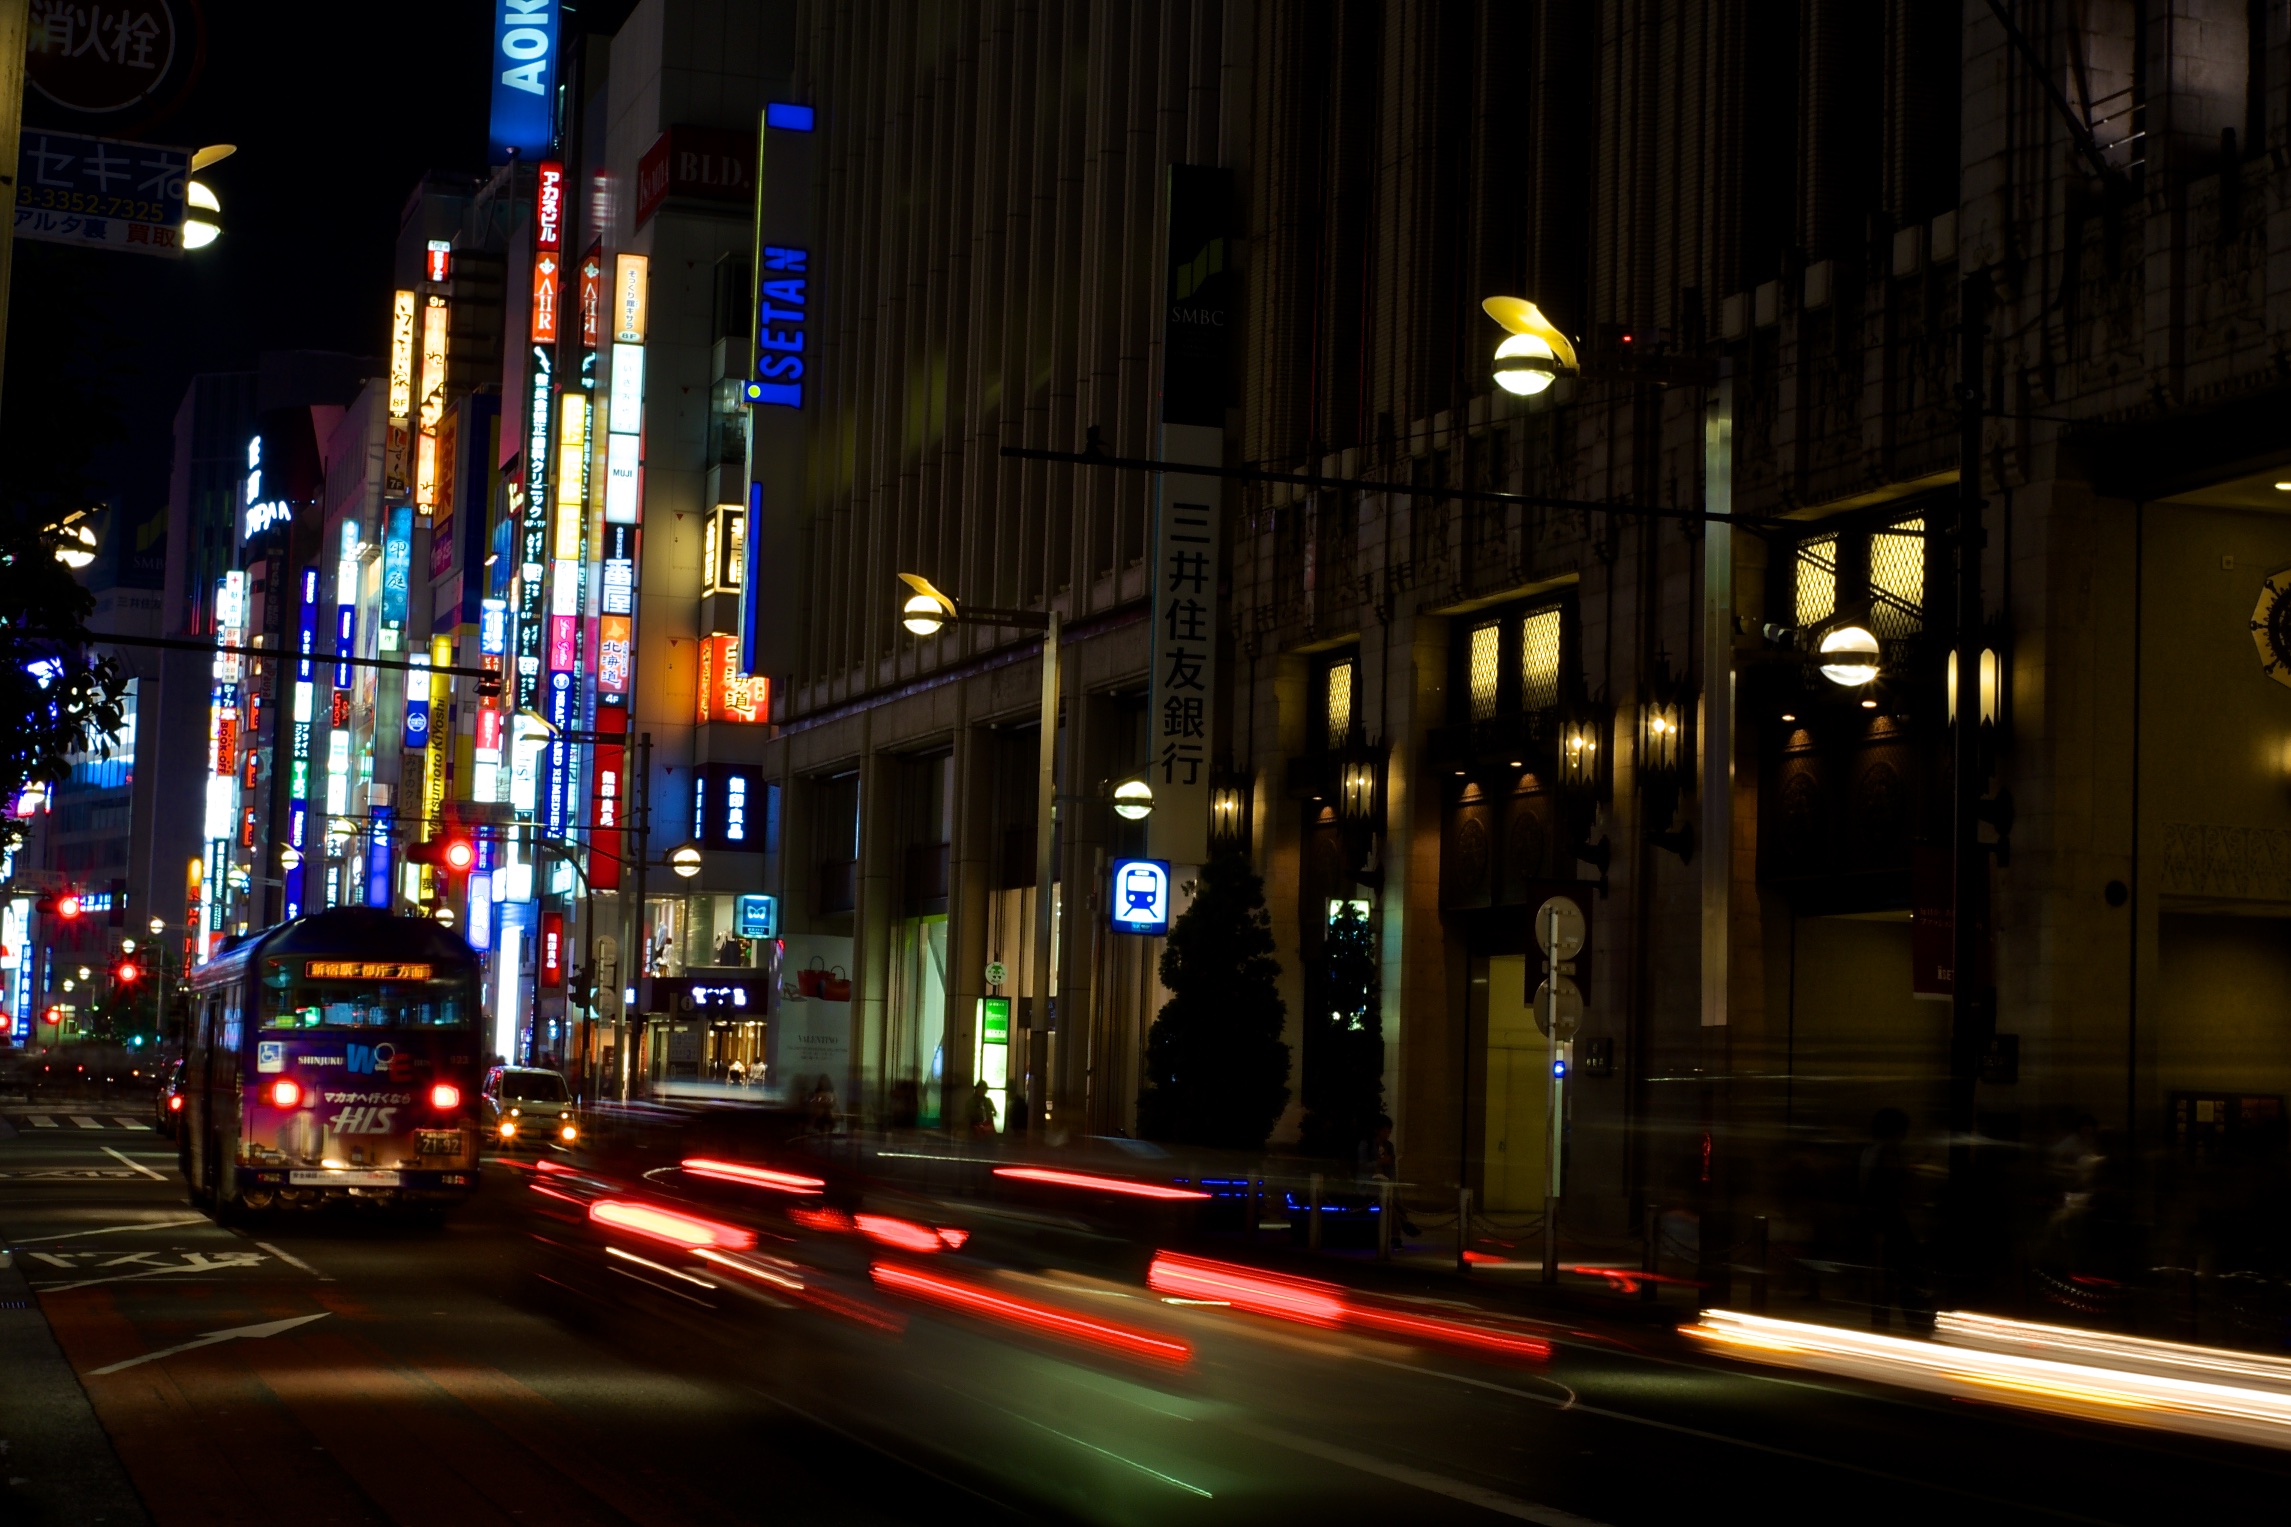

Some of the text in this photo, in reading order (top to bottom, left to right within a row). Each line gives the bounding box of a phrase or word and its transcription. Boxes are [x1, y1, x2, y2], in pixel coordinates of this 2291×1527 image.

[28, 0, 160, 69] 消火栓
[27, 136, 187, 200] セキネ
[679, 151, 750, 190] BLD.
[540, 171, 560, 243] アカネビル
[14, 209, 176, 248] アルタ裏 買取
[745, 246, 807, 410] ISETAN
[1171, 305, 1225, 328] SMBC
[613, 468, 633, 479] MUJI
[602, 641, 621, 685] 北海道
[1161, 502, 1211, 787] 三井住友銀行
[333, 693, 341, 727] union
[429, 753, 442, 834] Matsumoto
[298, 1056, 344, 1066] SHINJUKU
[324, 1092, 412, 1105] マカオへ行くなら
[329, 1106, 400, 1135] HIS
